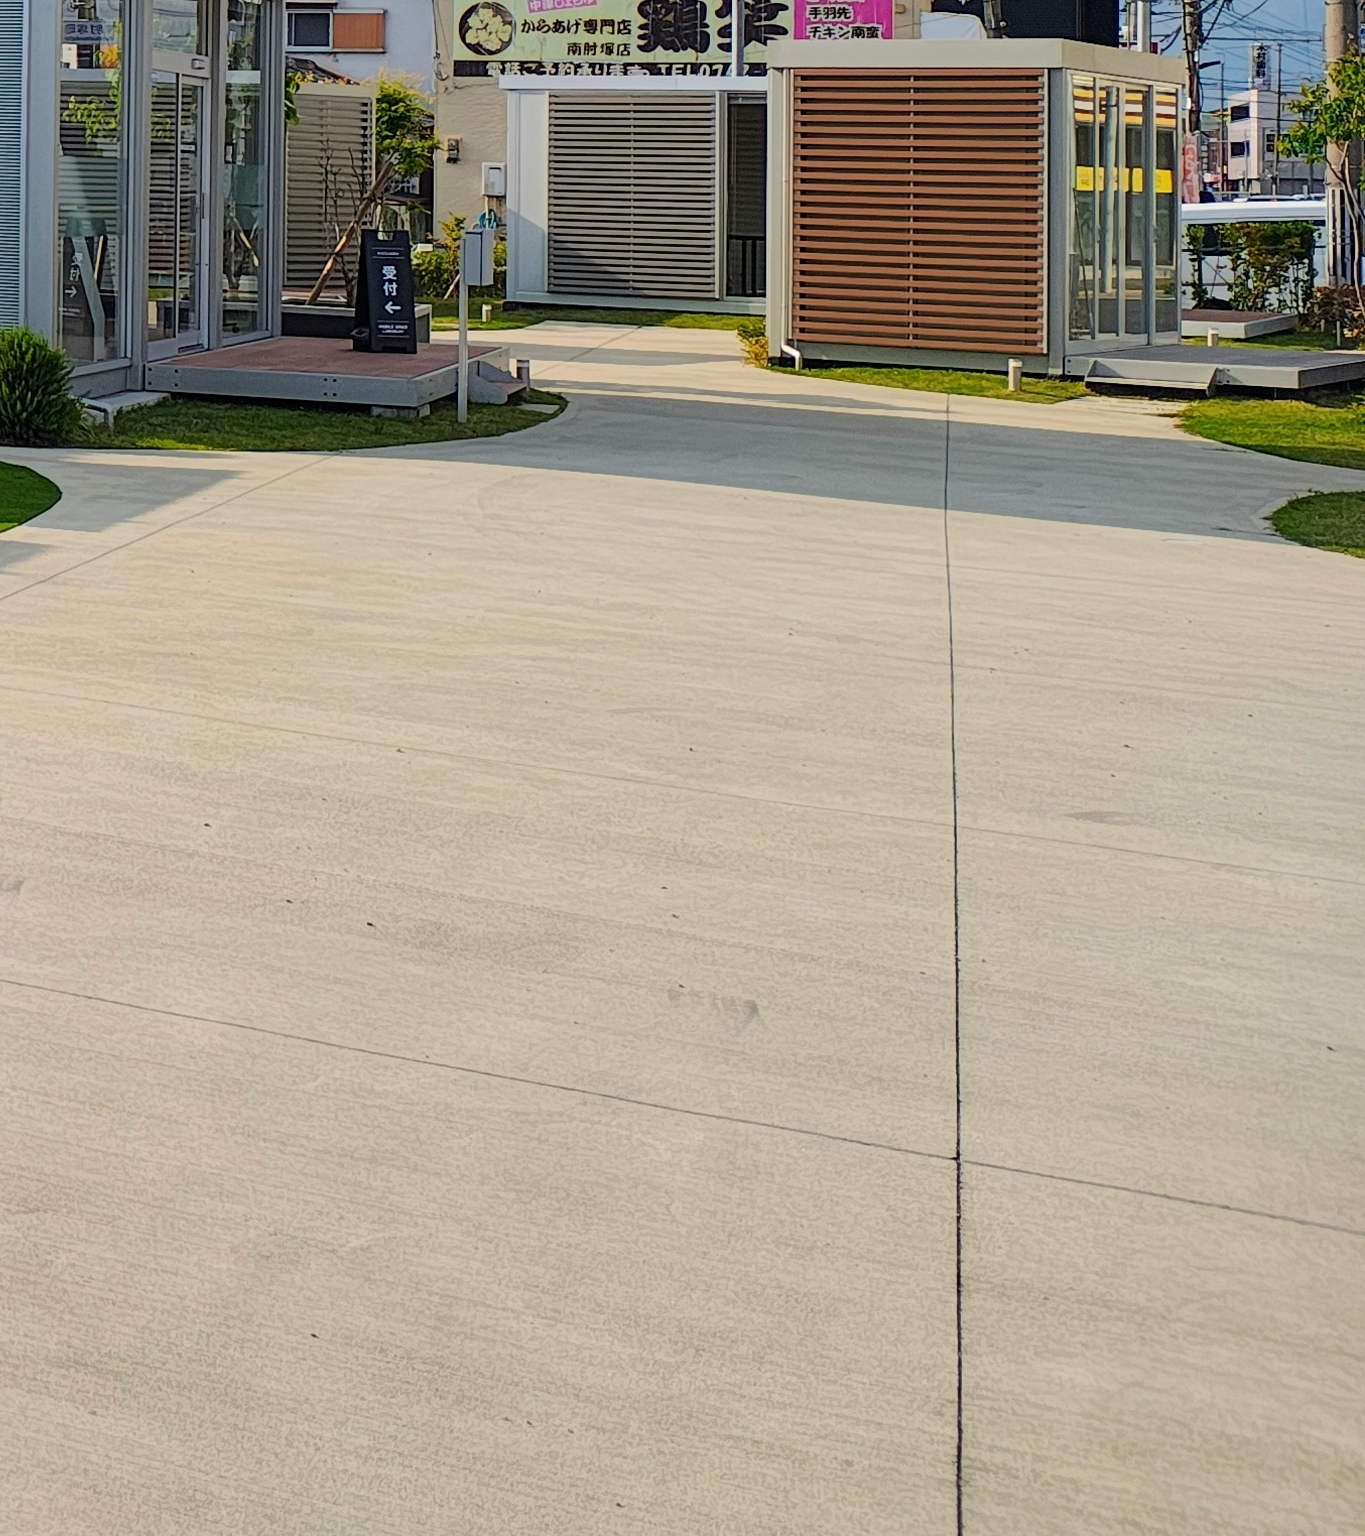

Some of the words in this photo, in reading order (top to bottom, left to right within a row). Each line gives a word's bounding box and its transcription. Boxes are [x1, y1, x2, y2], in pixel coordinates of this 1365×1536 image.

[809, 6, 852, 19] 手羽先
[520, 18, 632, 36] からあげ専門店
[382, 266, 397, 296] 受付
